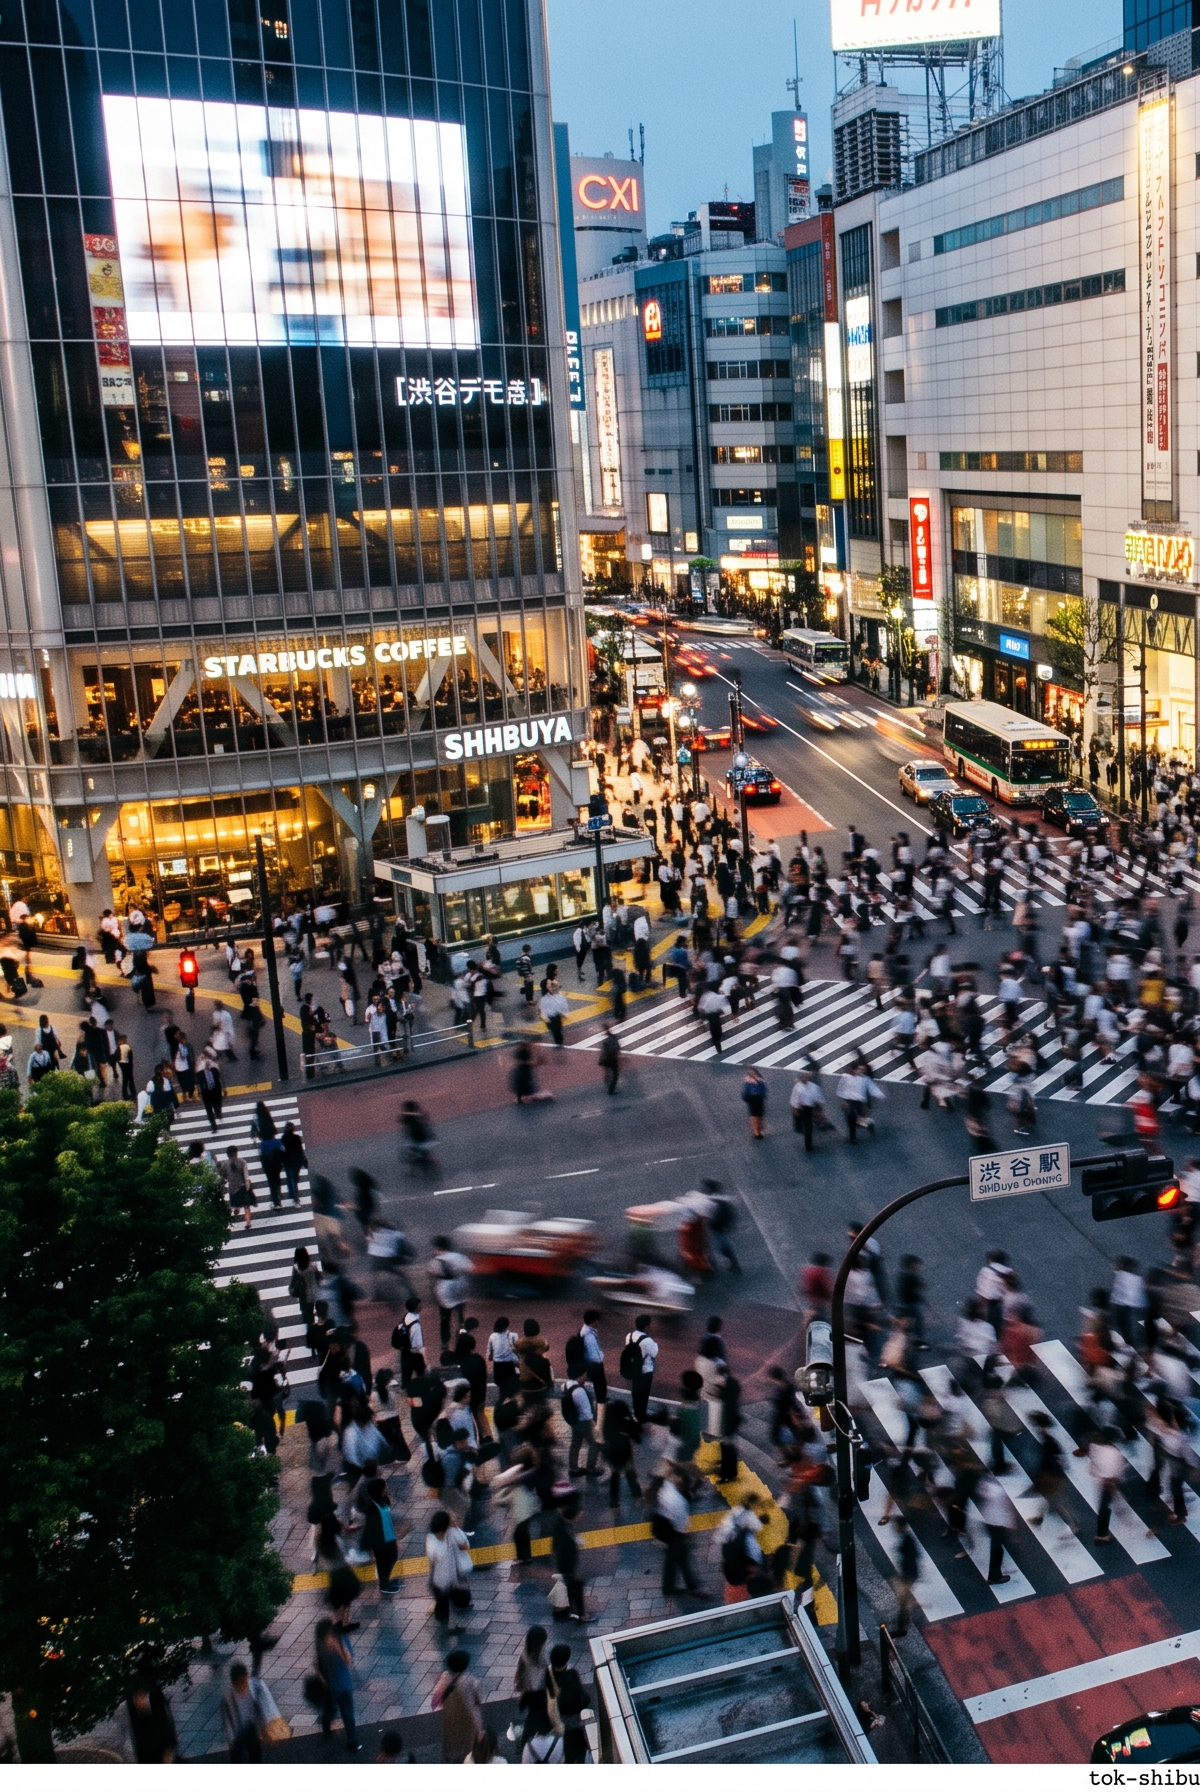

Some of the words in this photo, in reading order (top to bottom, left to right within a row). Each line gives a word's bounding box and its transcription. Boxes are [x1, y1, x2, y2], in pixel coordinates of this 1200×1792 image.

[577, 174, 640, 212] CXI
[203, 645, 367, 679] STARBUCKS
[373, 635, 467, 664] COFFEE
[979, 1152, 1060, 1182] 渋谷駅
